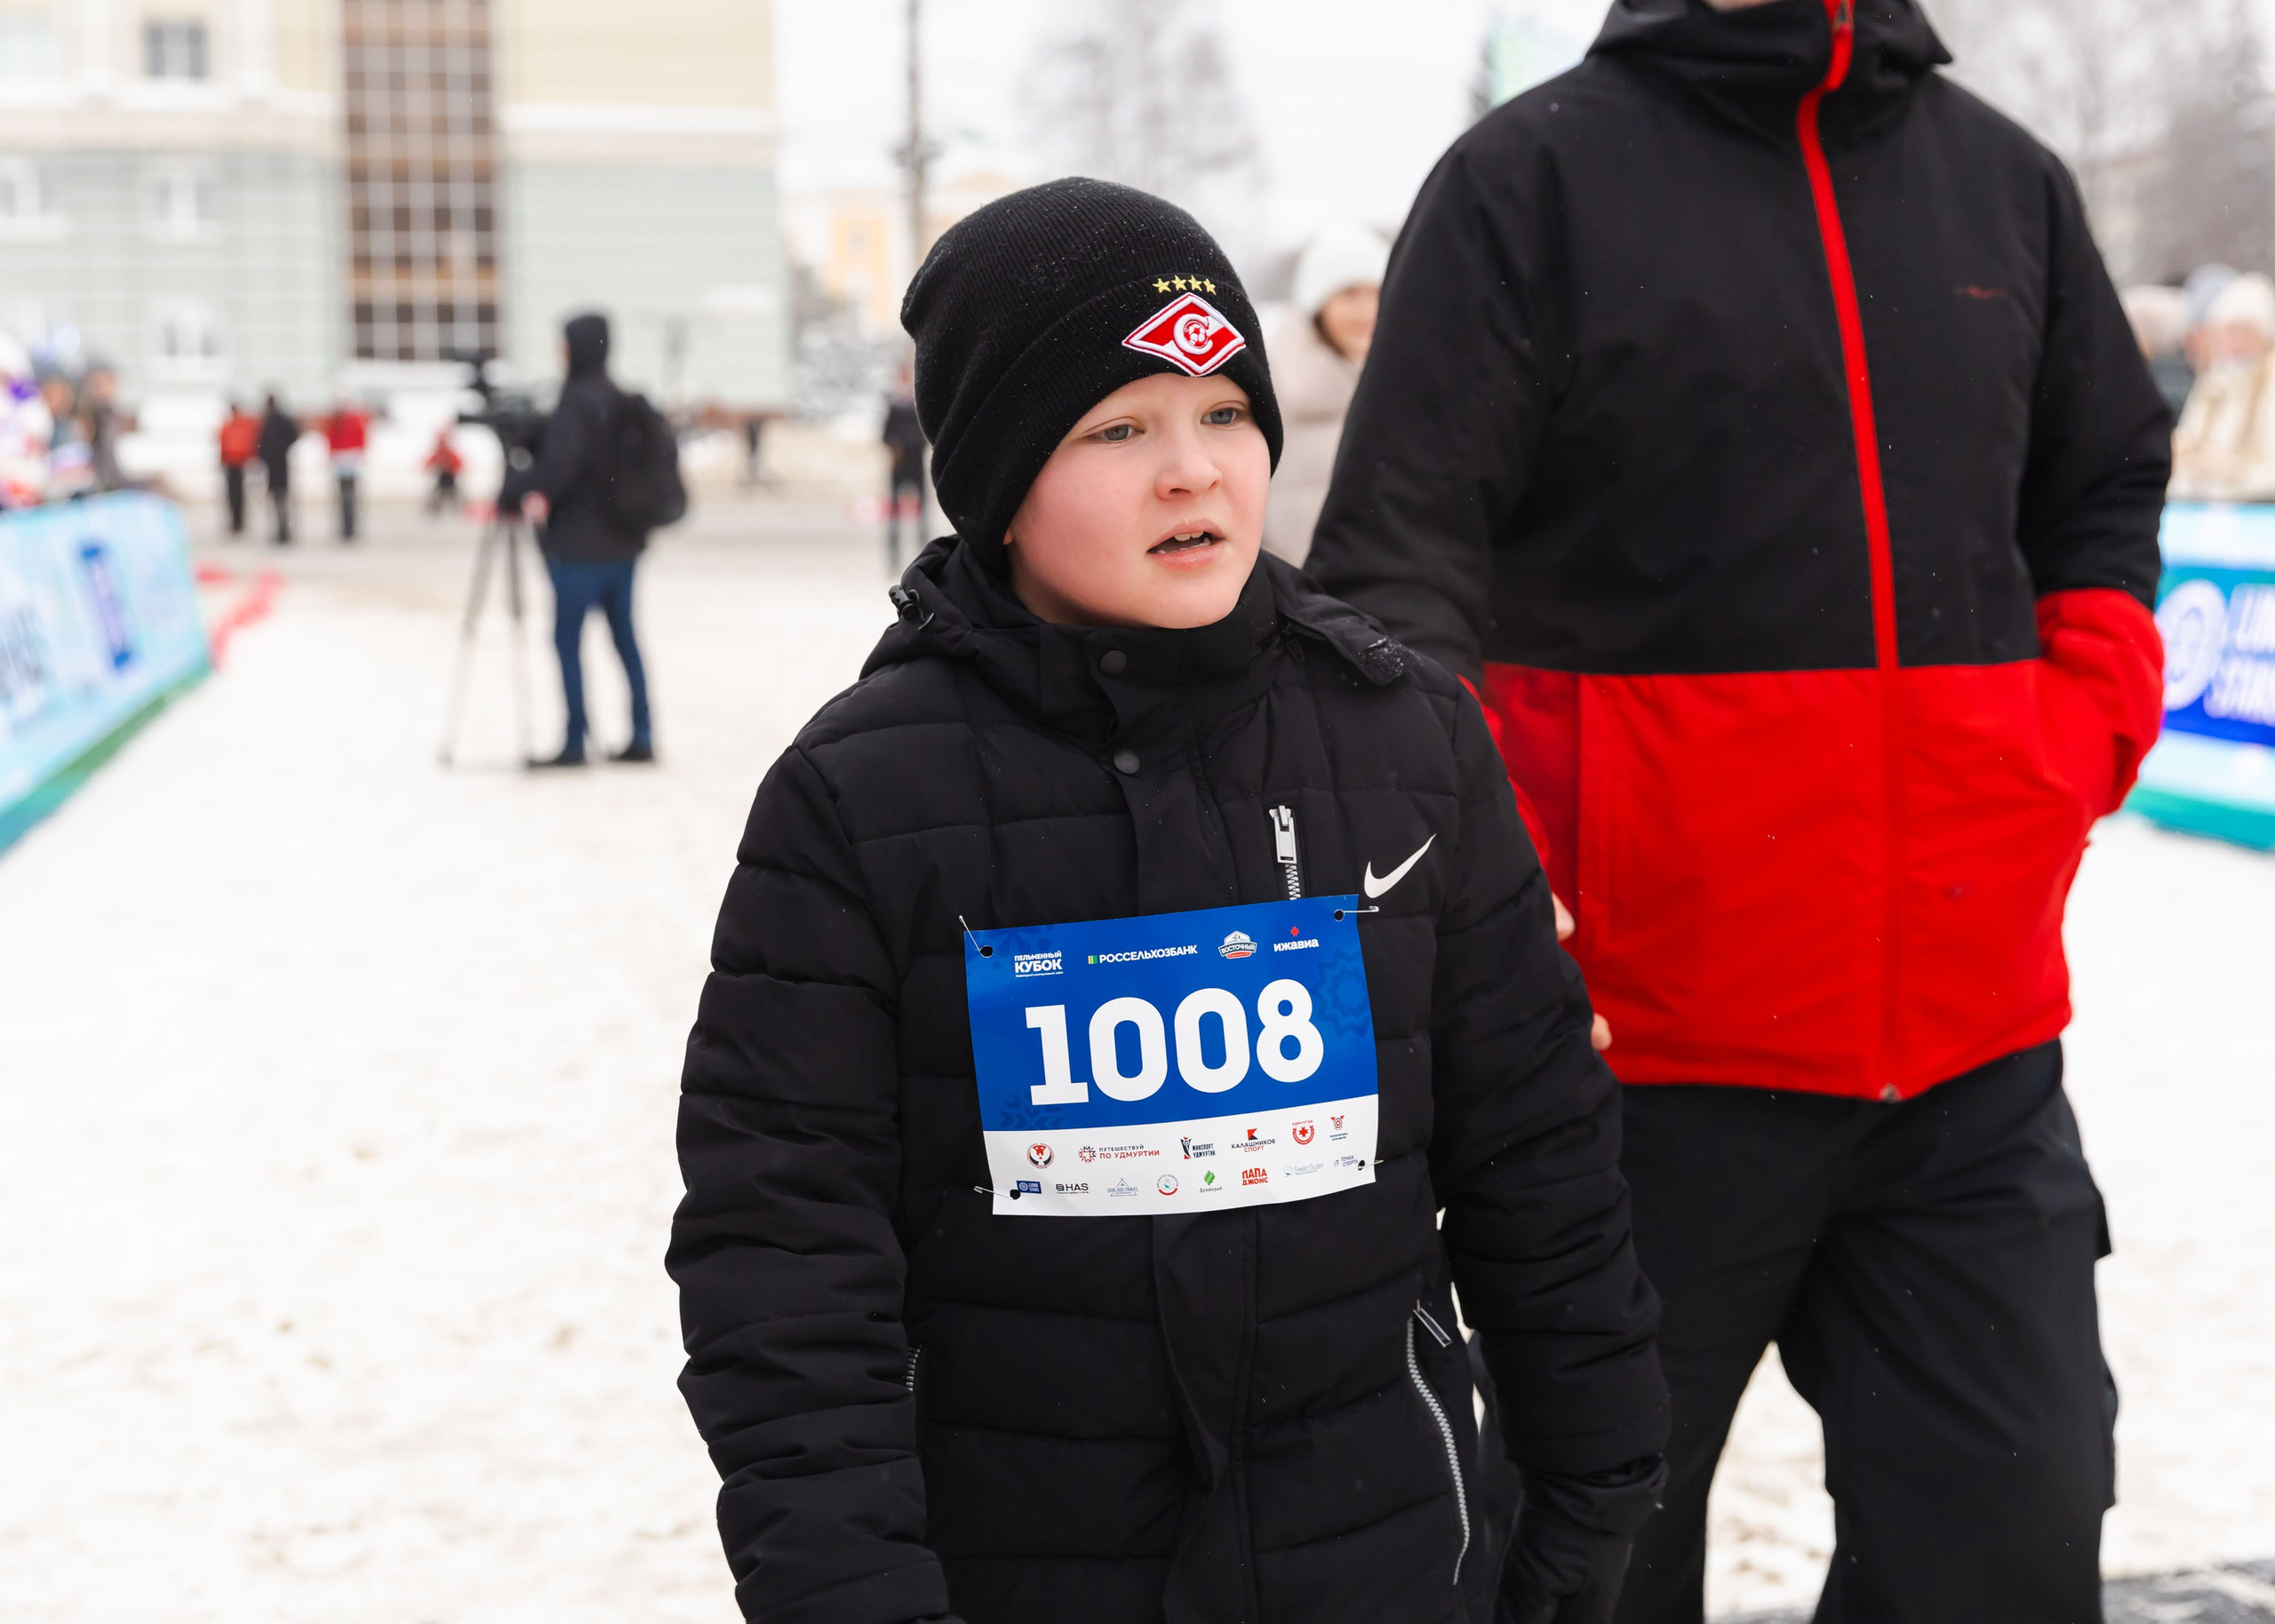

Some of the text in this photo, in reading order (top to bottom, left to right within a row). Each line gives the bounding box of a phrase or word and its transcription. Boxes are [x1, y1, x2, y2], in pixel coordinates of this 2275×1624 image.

[1220, 942, 1256, 954] ВОСТОЧНЫЙ
[1014, 951, 1062, 961] ПЕЛЬМЕННЫЙ
[1099, 944, 1198, 964] РОССЕЛЬХОЗБАНК
[1014, 959, 1063, 973] КУБОК
[1026, 978, 1325, 1106] 1008
[1231, 1139, 1276, 1150] КАЛАШНИКОВ
[1114, 1150, 1160, 1158] УДМУРТИИ
[1241, 1167, 1268, 1180] ПАПА
[1066, 1182, 1090, 1191] HAS
[1241, 1177, 1269, 1186] ДЖОНС
